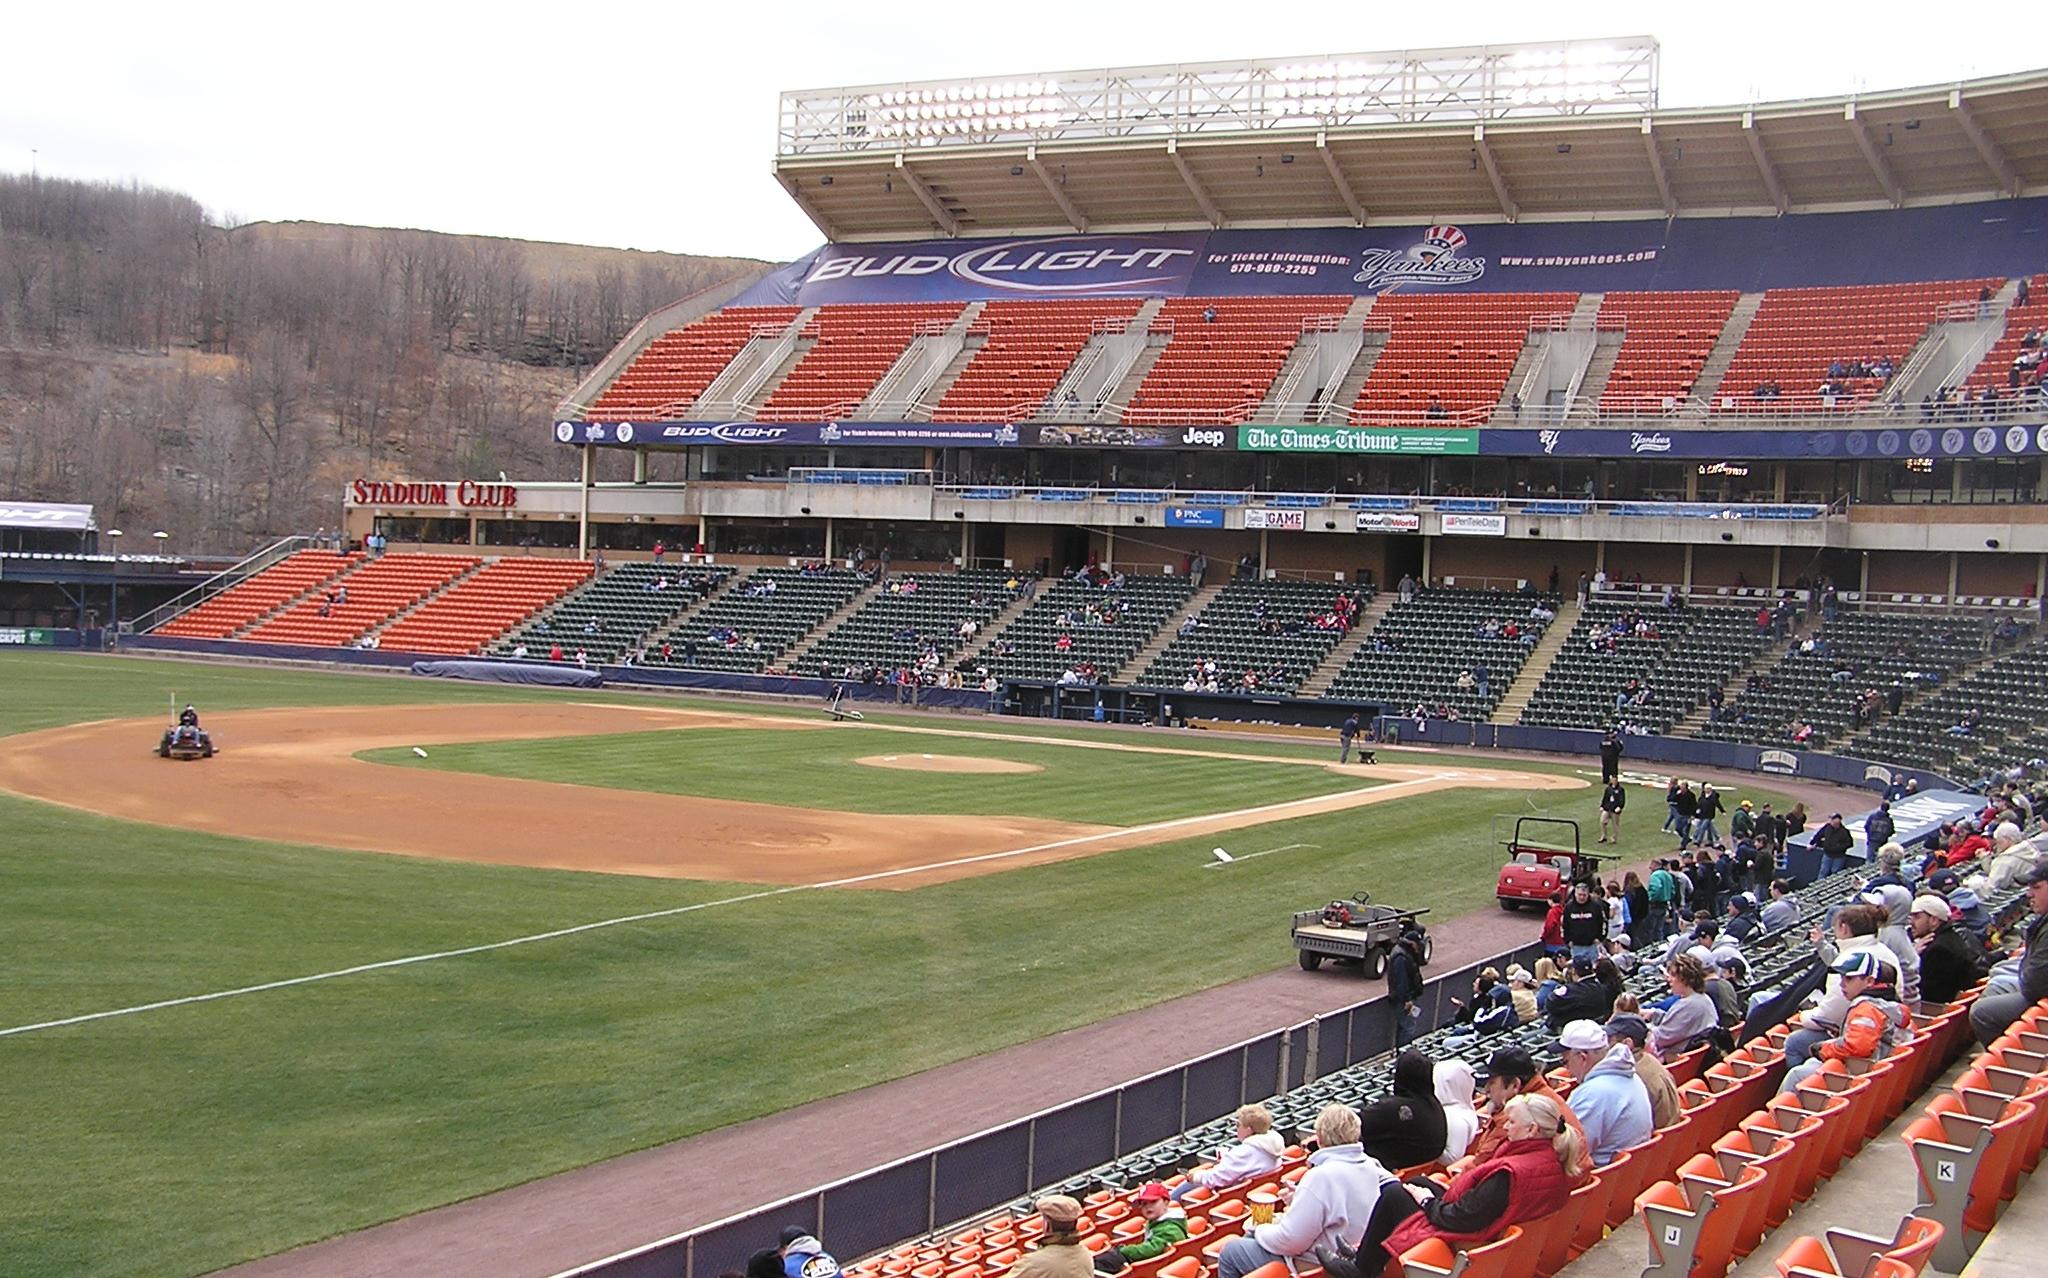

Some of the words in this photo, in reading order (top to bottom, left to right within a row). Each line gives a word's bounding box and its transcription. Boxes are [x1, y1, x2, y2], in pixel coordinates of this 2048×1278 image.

[1208, 254, 1229, 264] For
[1230, 252, 1269, 262] Ticket
[1270, 252, 1351, 265] Information:
[1500, 250, 1657, 266] www.swbyankees.com
[807, 256, 949, 283] BUD
[976, 248, 1195, 273] LIGHT
[1353, 248, 1486, 283] Yankees
[663, 426, 711, 437] BUD
[719, 427, 788, 438] LIGHT
[1182, 426, 1225, 447] Jeep
[1247, 427, 1278, 448] The
[1280, 427, 1400, 450] Times-Tribune
[353, 479, 449, 506] STADIUM
[457, 480, 518, 507] CLUB
[1183, 509, 1203, 519] PNC
[1268, 512, 1302, 525] GAME
[1358, 517, 1383, 526] Motor
[1391, 519, 1417, 527] World
[1940, 1164, 1952, 1178] K
[1668, 1230, 1677, 1241] J
